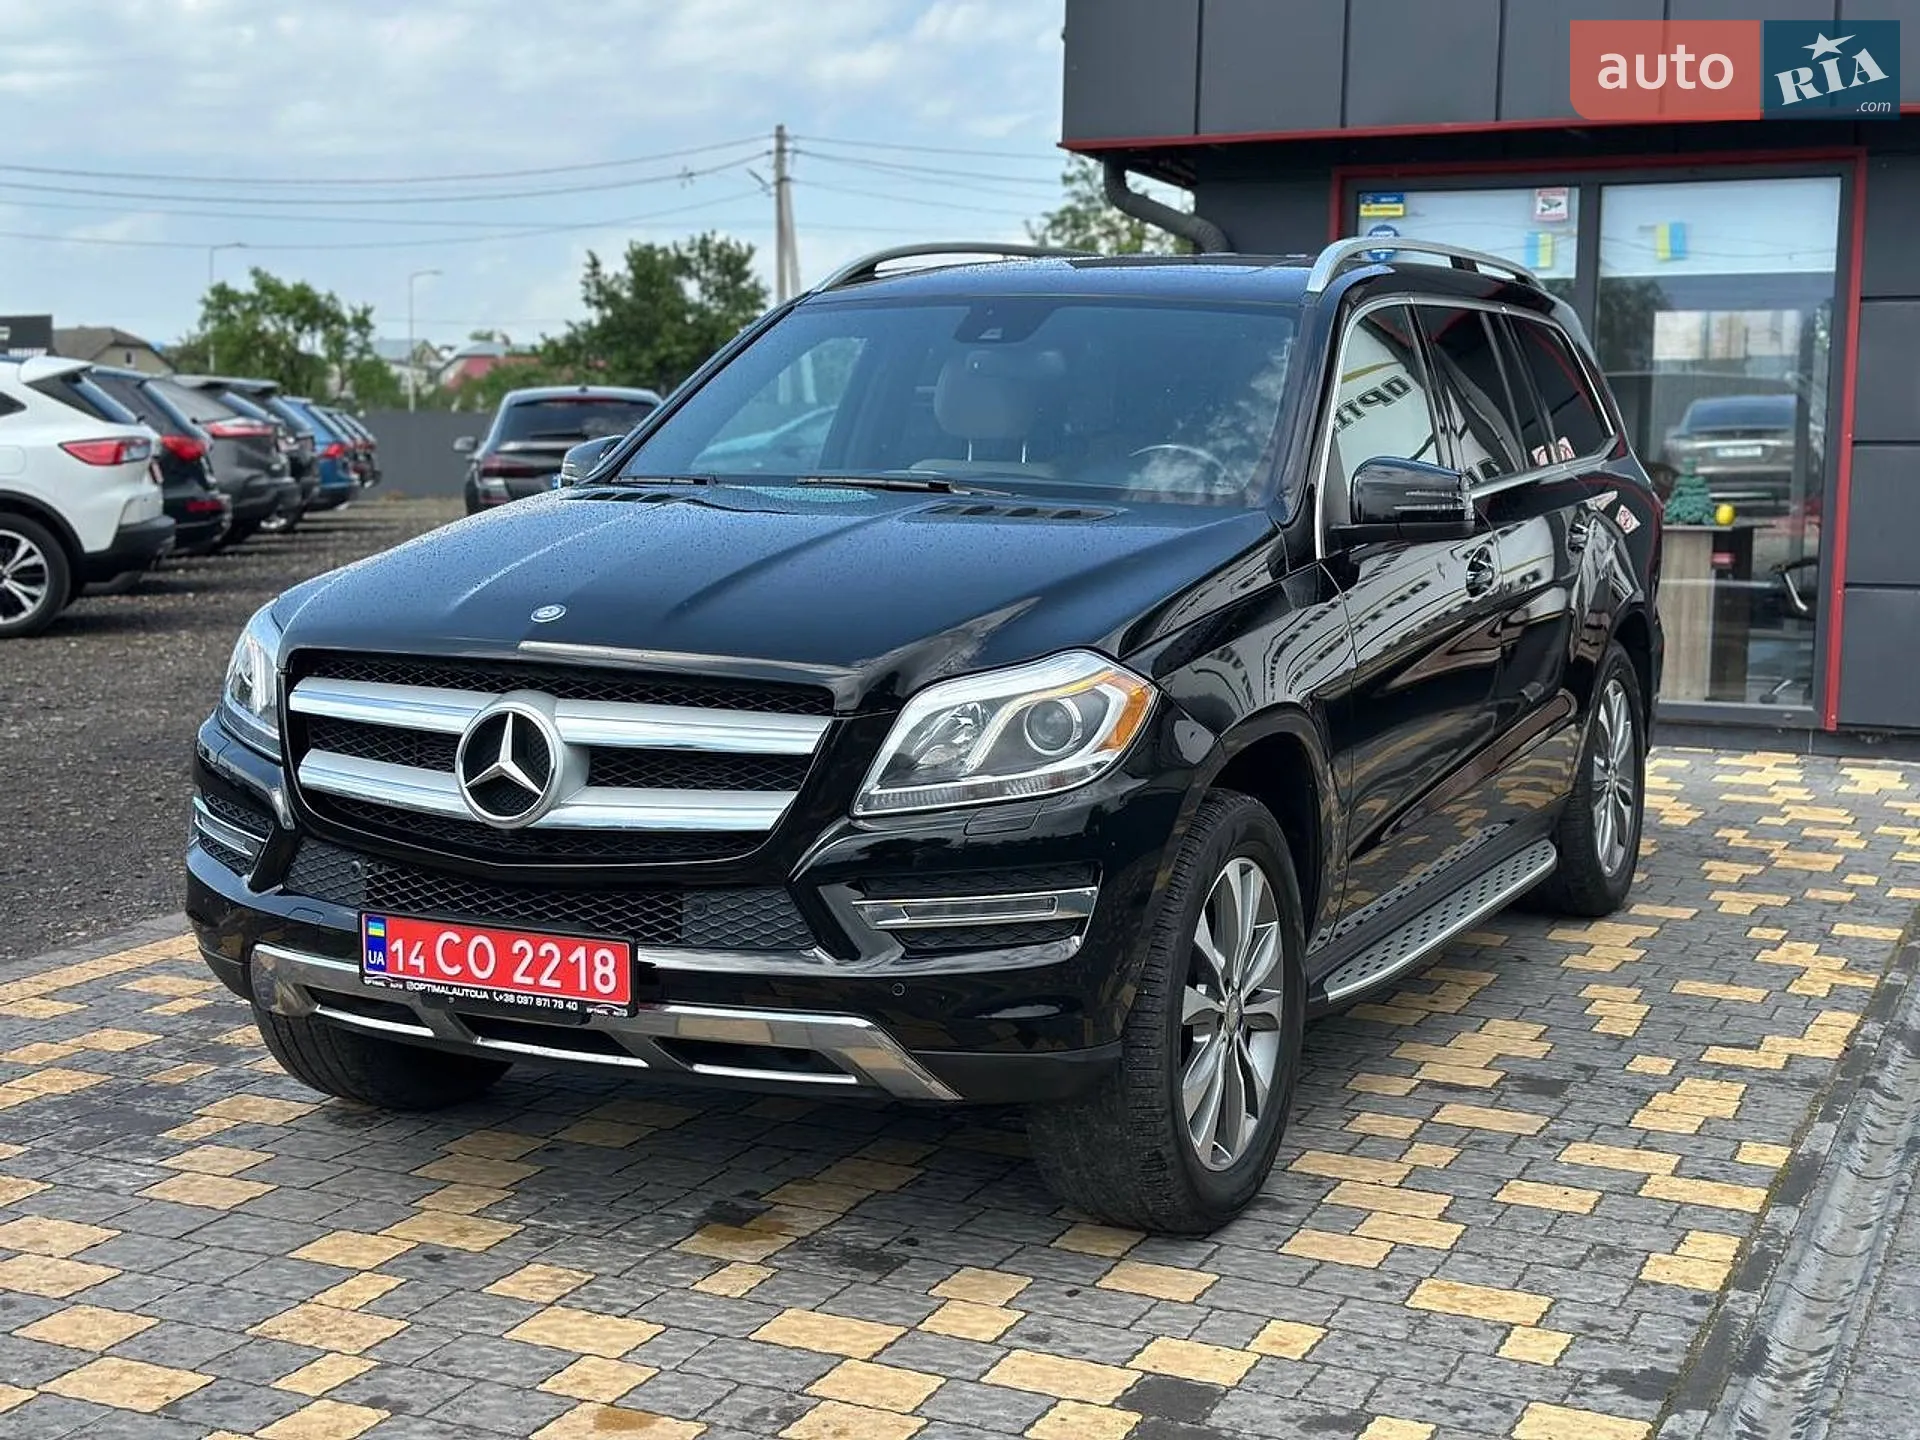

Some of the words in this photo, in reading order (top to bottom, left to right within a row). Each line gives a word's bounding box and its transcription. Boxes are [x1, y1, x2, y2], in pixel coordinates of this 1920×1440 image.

[367, 950, 385, 966] UA
[390, 938, 426, 974] 14
[435, 931, 496, 980] CO
[511, 938, 617, 994] 2218
[565, 1001, 578, 1011] 40
